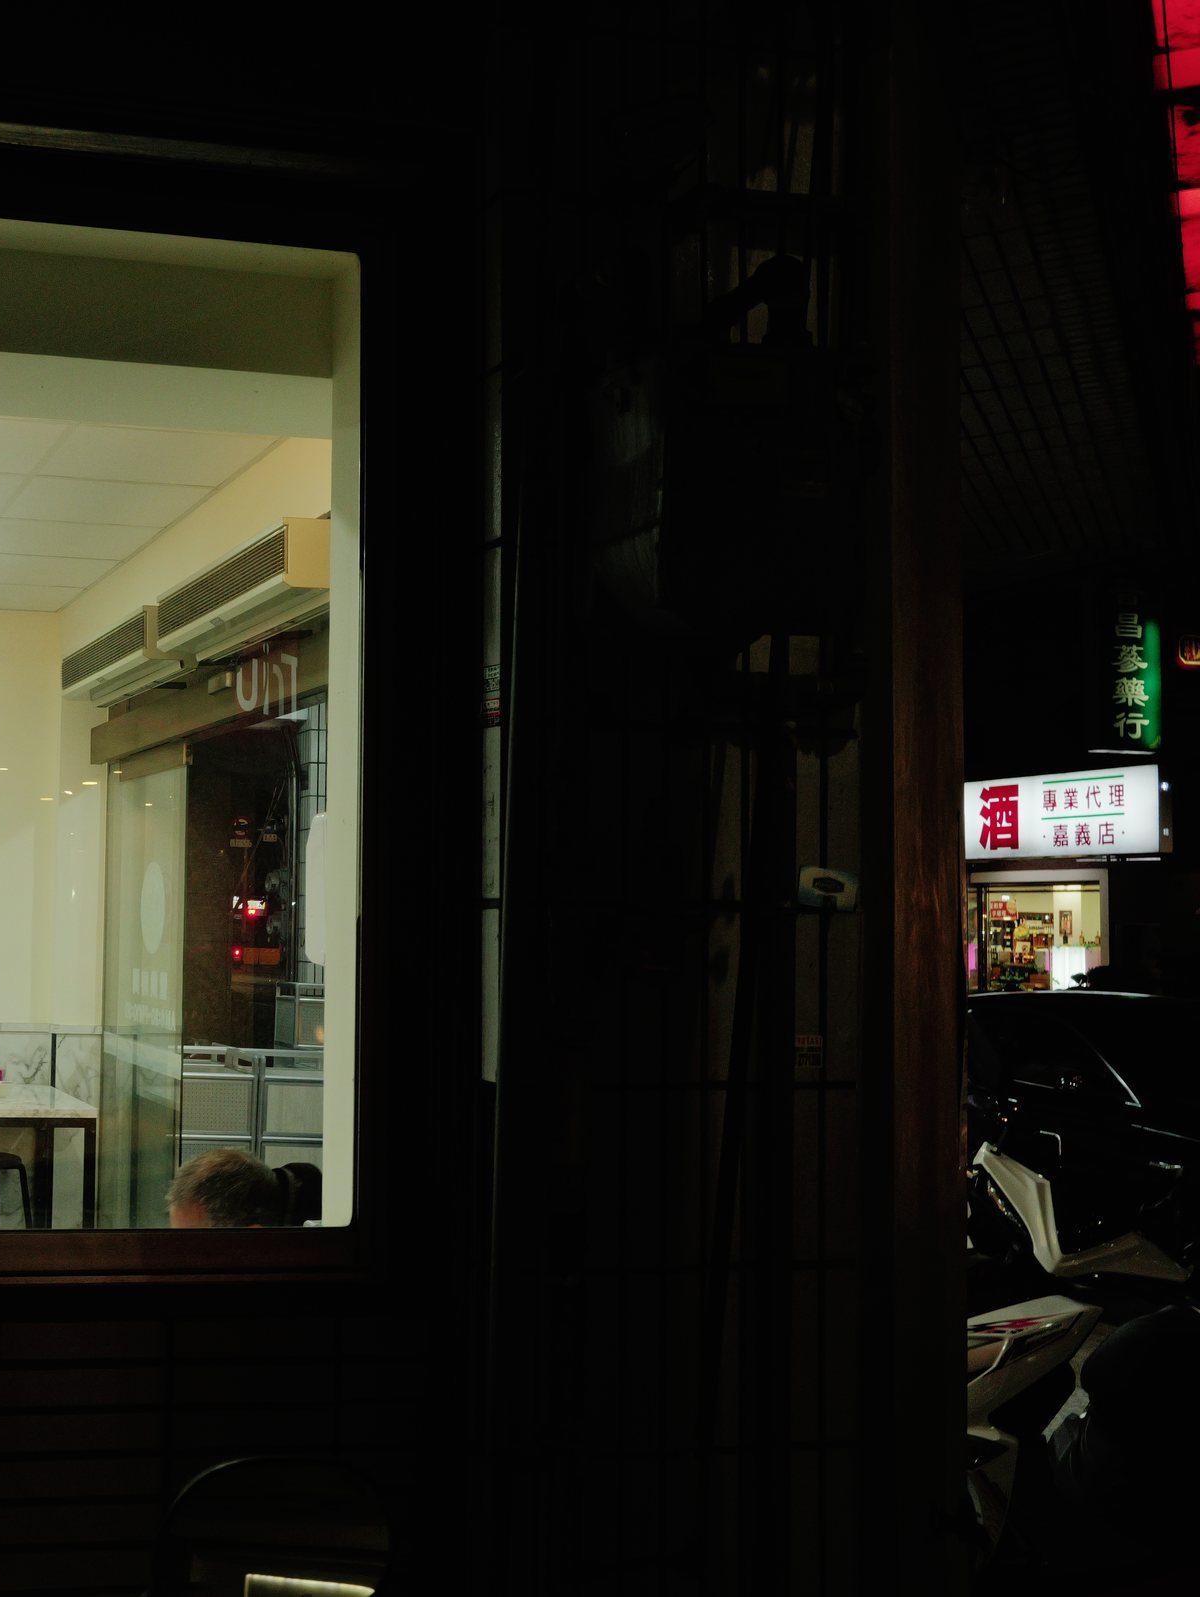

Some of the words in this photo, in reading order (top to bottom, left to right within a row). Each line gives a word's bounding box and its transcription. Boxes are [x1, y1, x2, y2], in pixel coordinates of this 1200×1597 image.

[1042, 784, 1125, 812] 專業代理
[979, 784, 1019, 851] 酒
[1053, 821, 1115, 848] 嘉義店
